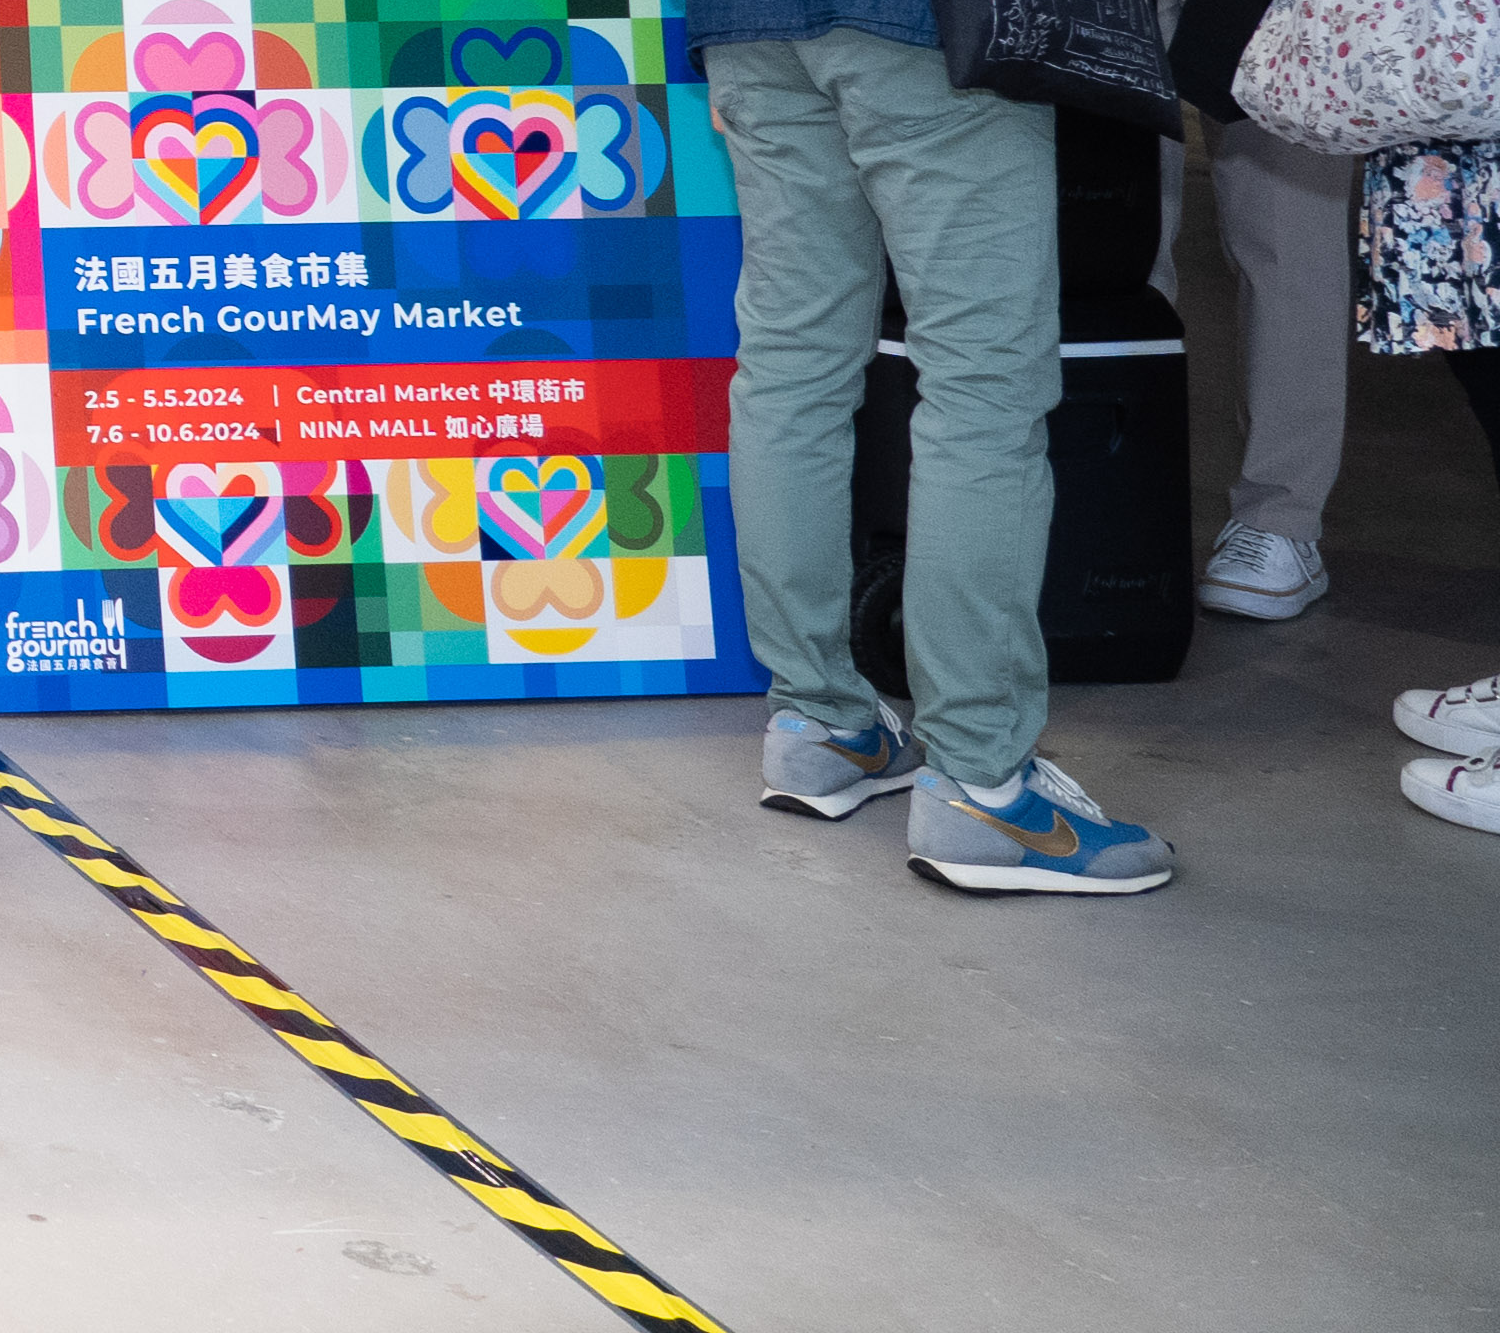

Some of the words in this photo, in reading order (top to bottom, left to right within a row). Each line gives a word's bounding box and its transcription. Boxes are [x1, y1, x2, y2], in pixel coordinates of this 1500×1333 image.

[73, 251, 370, 293] 法國五月美食市集
[76, 306, 206, 335] French
[216, 303, 381, 337] GourMay
[393, 300, 523, 329] Market
[84, 390, 120, 409] 2.5
[143, 388, 244, 408] 5.5.2024
[296, 384, 387, 405] Central
[393, 383, 480, 403] Market
[487, 378, 586, 404] 中環街市
[86, 424, 123, 444] 7.6
[147, 422, 261, 443] 10.6.2024
[299, 420, 362, 440] NINA
[368, 418, 438, 438] MALL
[444, 414, 545, 440] 如心廣場
[5, 598, 98, 639] french
[5, 638, 128, 674] gourmay
